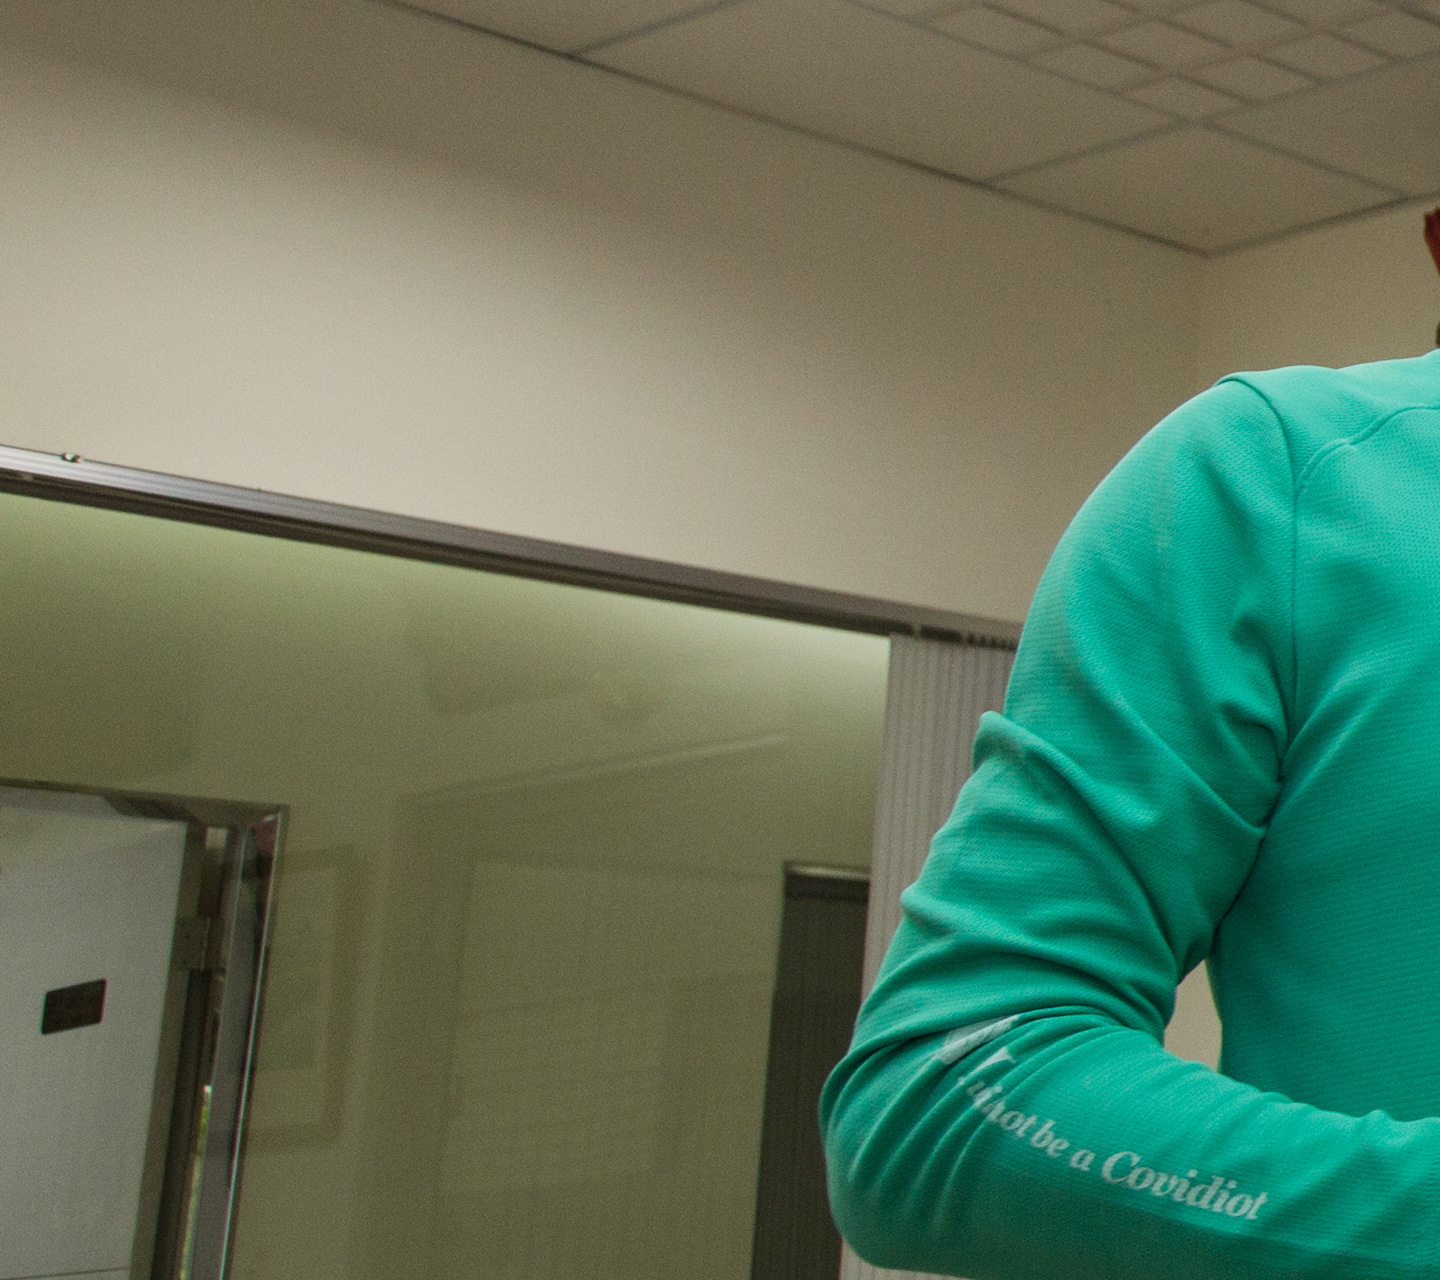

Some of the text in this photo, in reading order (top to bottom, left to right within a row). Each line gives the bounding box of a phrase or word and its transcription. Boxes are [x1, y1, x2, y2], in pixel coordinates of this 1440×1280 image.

[1029, 1119, 1070, 1158] be
[1069, 1148, 1097, 1172] a
[1101, 1150, 1269, 1220] Covidiot
